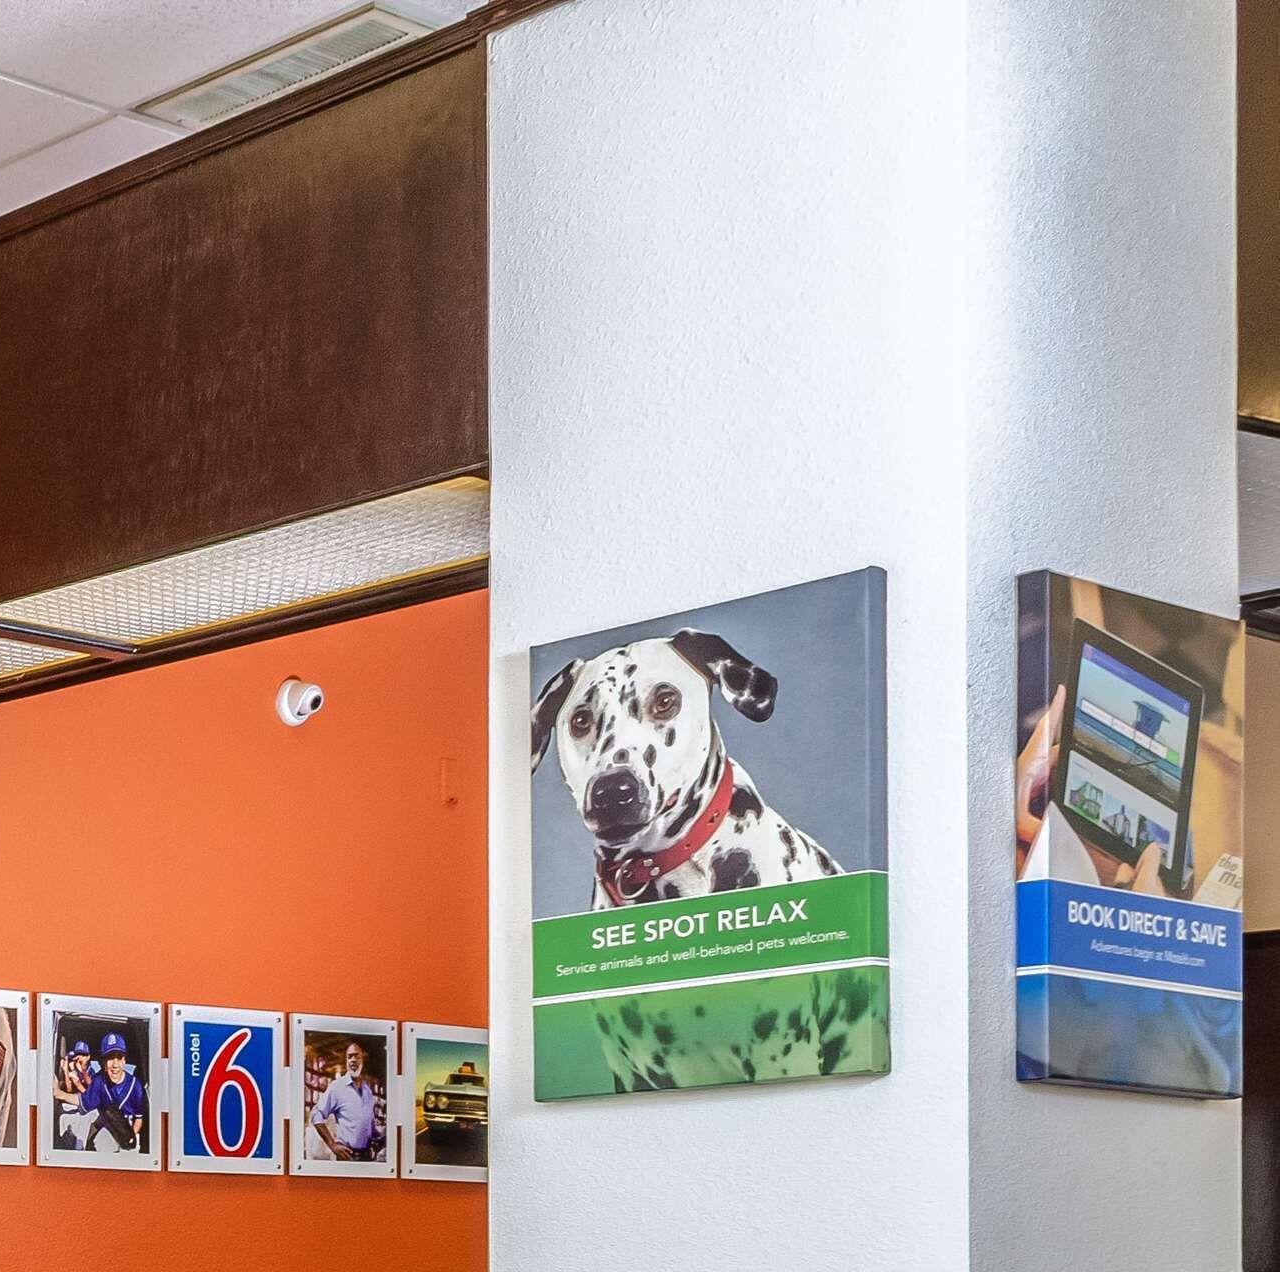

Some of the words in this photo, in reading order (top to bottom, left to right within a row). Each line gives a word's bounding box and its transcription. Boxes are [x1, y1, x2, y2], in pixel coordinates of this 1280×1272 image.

[591, 923, 636, 950] SEE
[643, 912, 711, 944] SPOT
[716, 898, 809, 932] RELAX
[1067, 900, 1116, 930] BOOK
[1118, 908, 1173, 939] DIRECT
[1175, 918, 1188, 941] &
[1190, 920, 1228, 947] SAVE
[555, 960, 598, 977] Service
[599, 954, 644, 973] animals
[645, 950, 669, 966] and
[671, 939, 755, 963] well-behaved
[756, 935, 786, 955] pets
[189, 1033, 201, 1077] motel
[198, 1027, 264, 1158] 6
